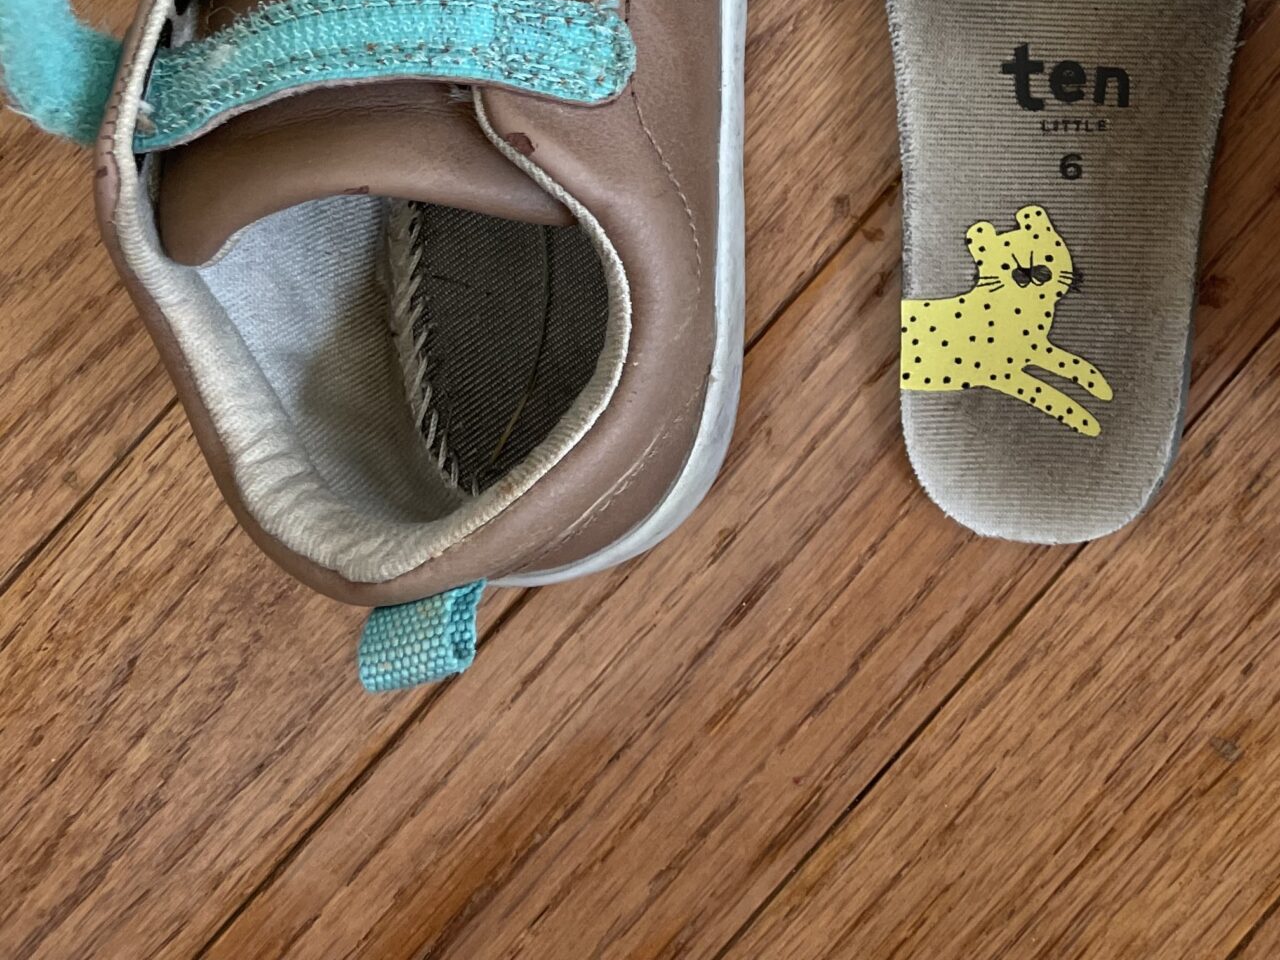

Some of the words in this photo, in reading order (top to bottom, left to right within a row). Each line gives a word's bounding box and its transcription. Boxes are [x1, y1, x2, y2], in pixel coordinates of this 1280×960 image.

[1001, 42, 1131, 112] ten
[1041, 119, 1108, 133] LITTLE
[1059, 152, 1083, 181] 6
